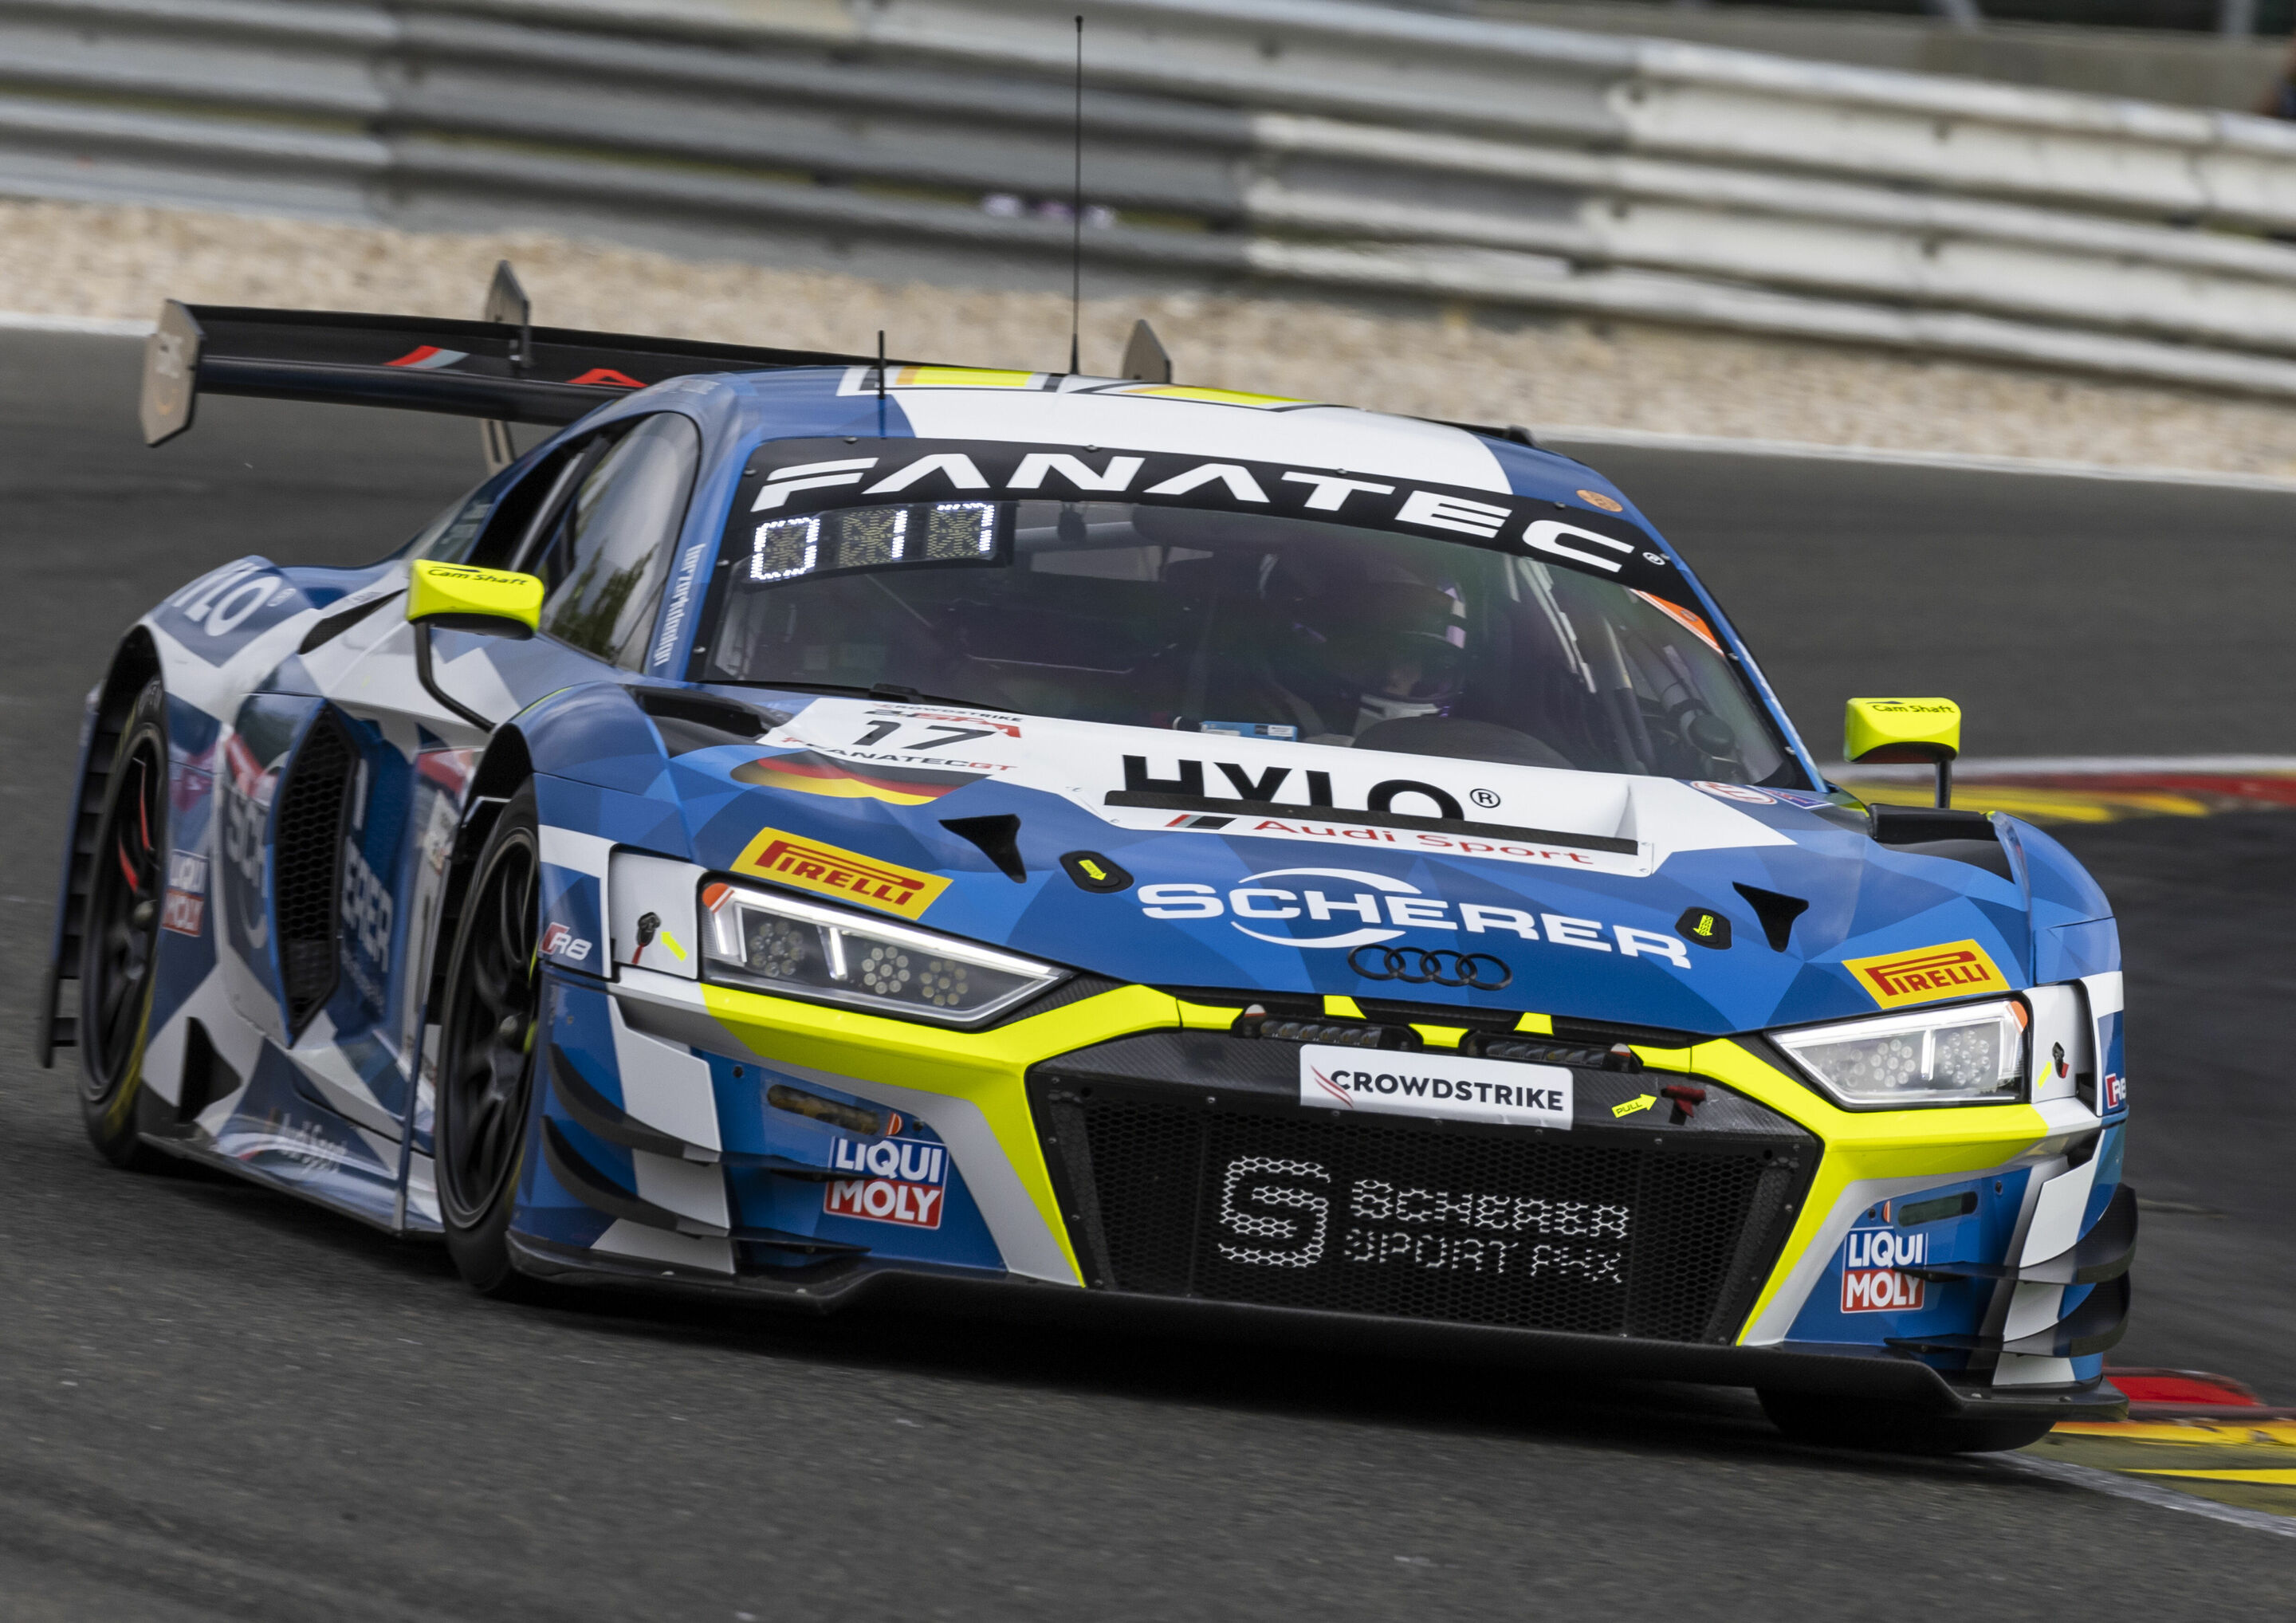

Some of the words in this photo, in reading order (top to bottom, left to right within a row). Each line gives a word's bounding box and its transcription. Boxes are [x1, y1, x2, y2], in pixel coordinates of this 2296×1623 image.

[750, 453, 1635, 573] FANATEC
[752, 501, 996, 580] 017
[428, 568, 469, 579] Cam
[473, 574, 529, 585] Shaft
[1909, 705, 1956, 713] Shaft
[851, 720, 997, 750] 17
[1253, 819, 1396, 842] Audi
[1416, 834, 1594, 865] Sport
[754, 839, 926, 906] PIRELLI
[1138, 882, 1692, 969] SCHERER
[1864, 950, 1991, 996] PIRELLI
[1330, 1070, 1564, 1111] CROWDSTRIKE
[1615, 1102, 1643, 1115] PULL
[835, 1138, 943, 1184] LIQUI
[830, 1180, 942, 1223] MOLY
[1350, 1180, 1630, 1239] SCHERER
[1344, 1228, 1519, 1274] SPORT
[1848, 1231, 1924, 1268] LIQUI
[1846, 1271, 1921, 1308] MOLY
